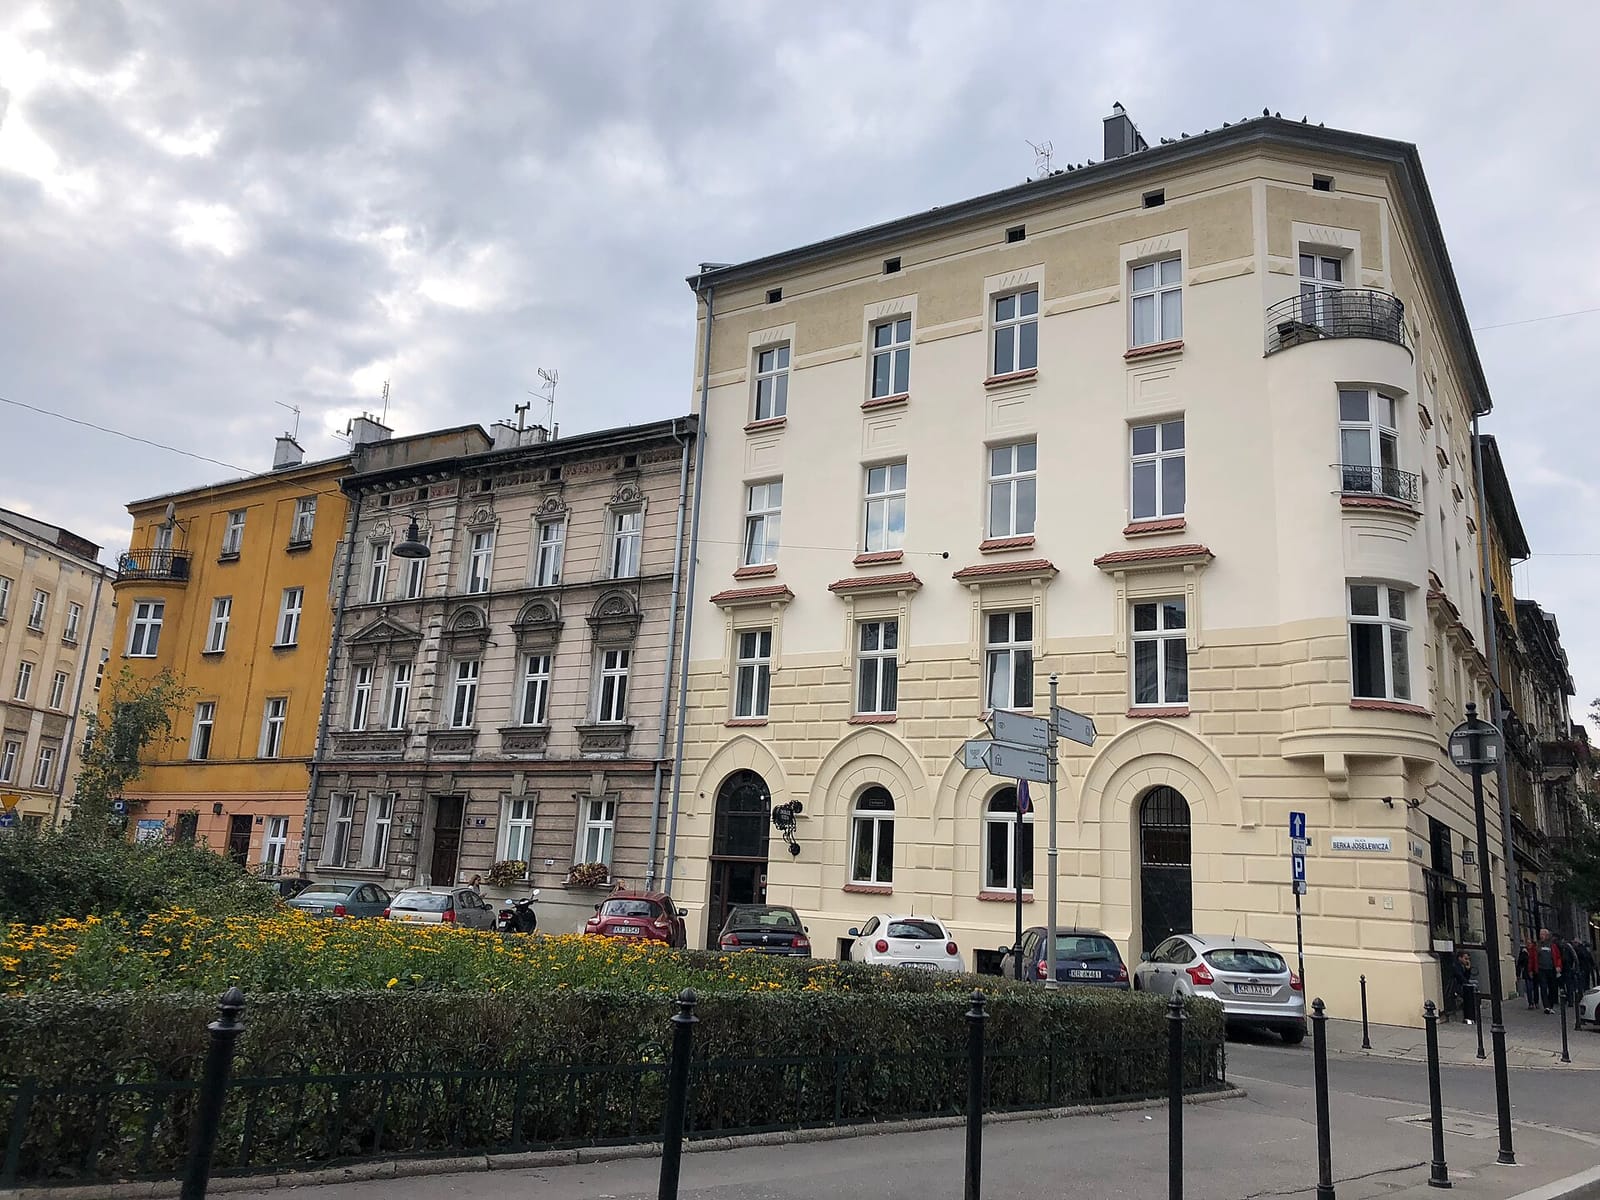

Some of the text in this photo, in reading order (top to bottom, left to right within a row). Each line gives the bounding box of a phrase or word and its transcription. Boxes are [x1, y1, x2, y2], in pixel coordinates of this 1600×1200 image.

[1351, 842, 1389, 850] JOSELEWICZA
[1295, 858, 1303, 878] P
[1239, 984, 1249, 993] KR
